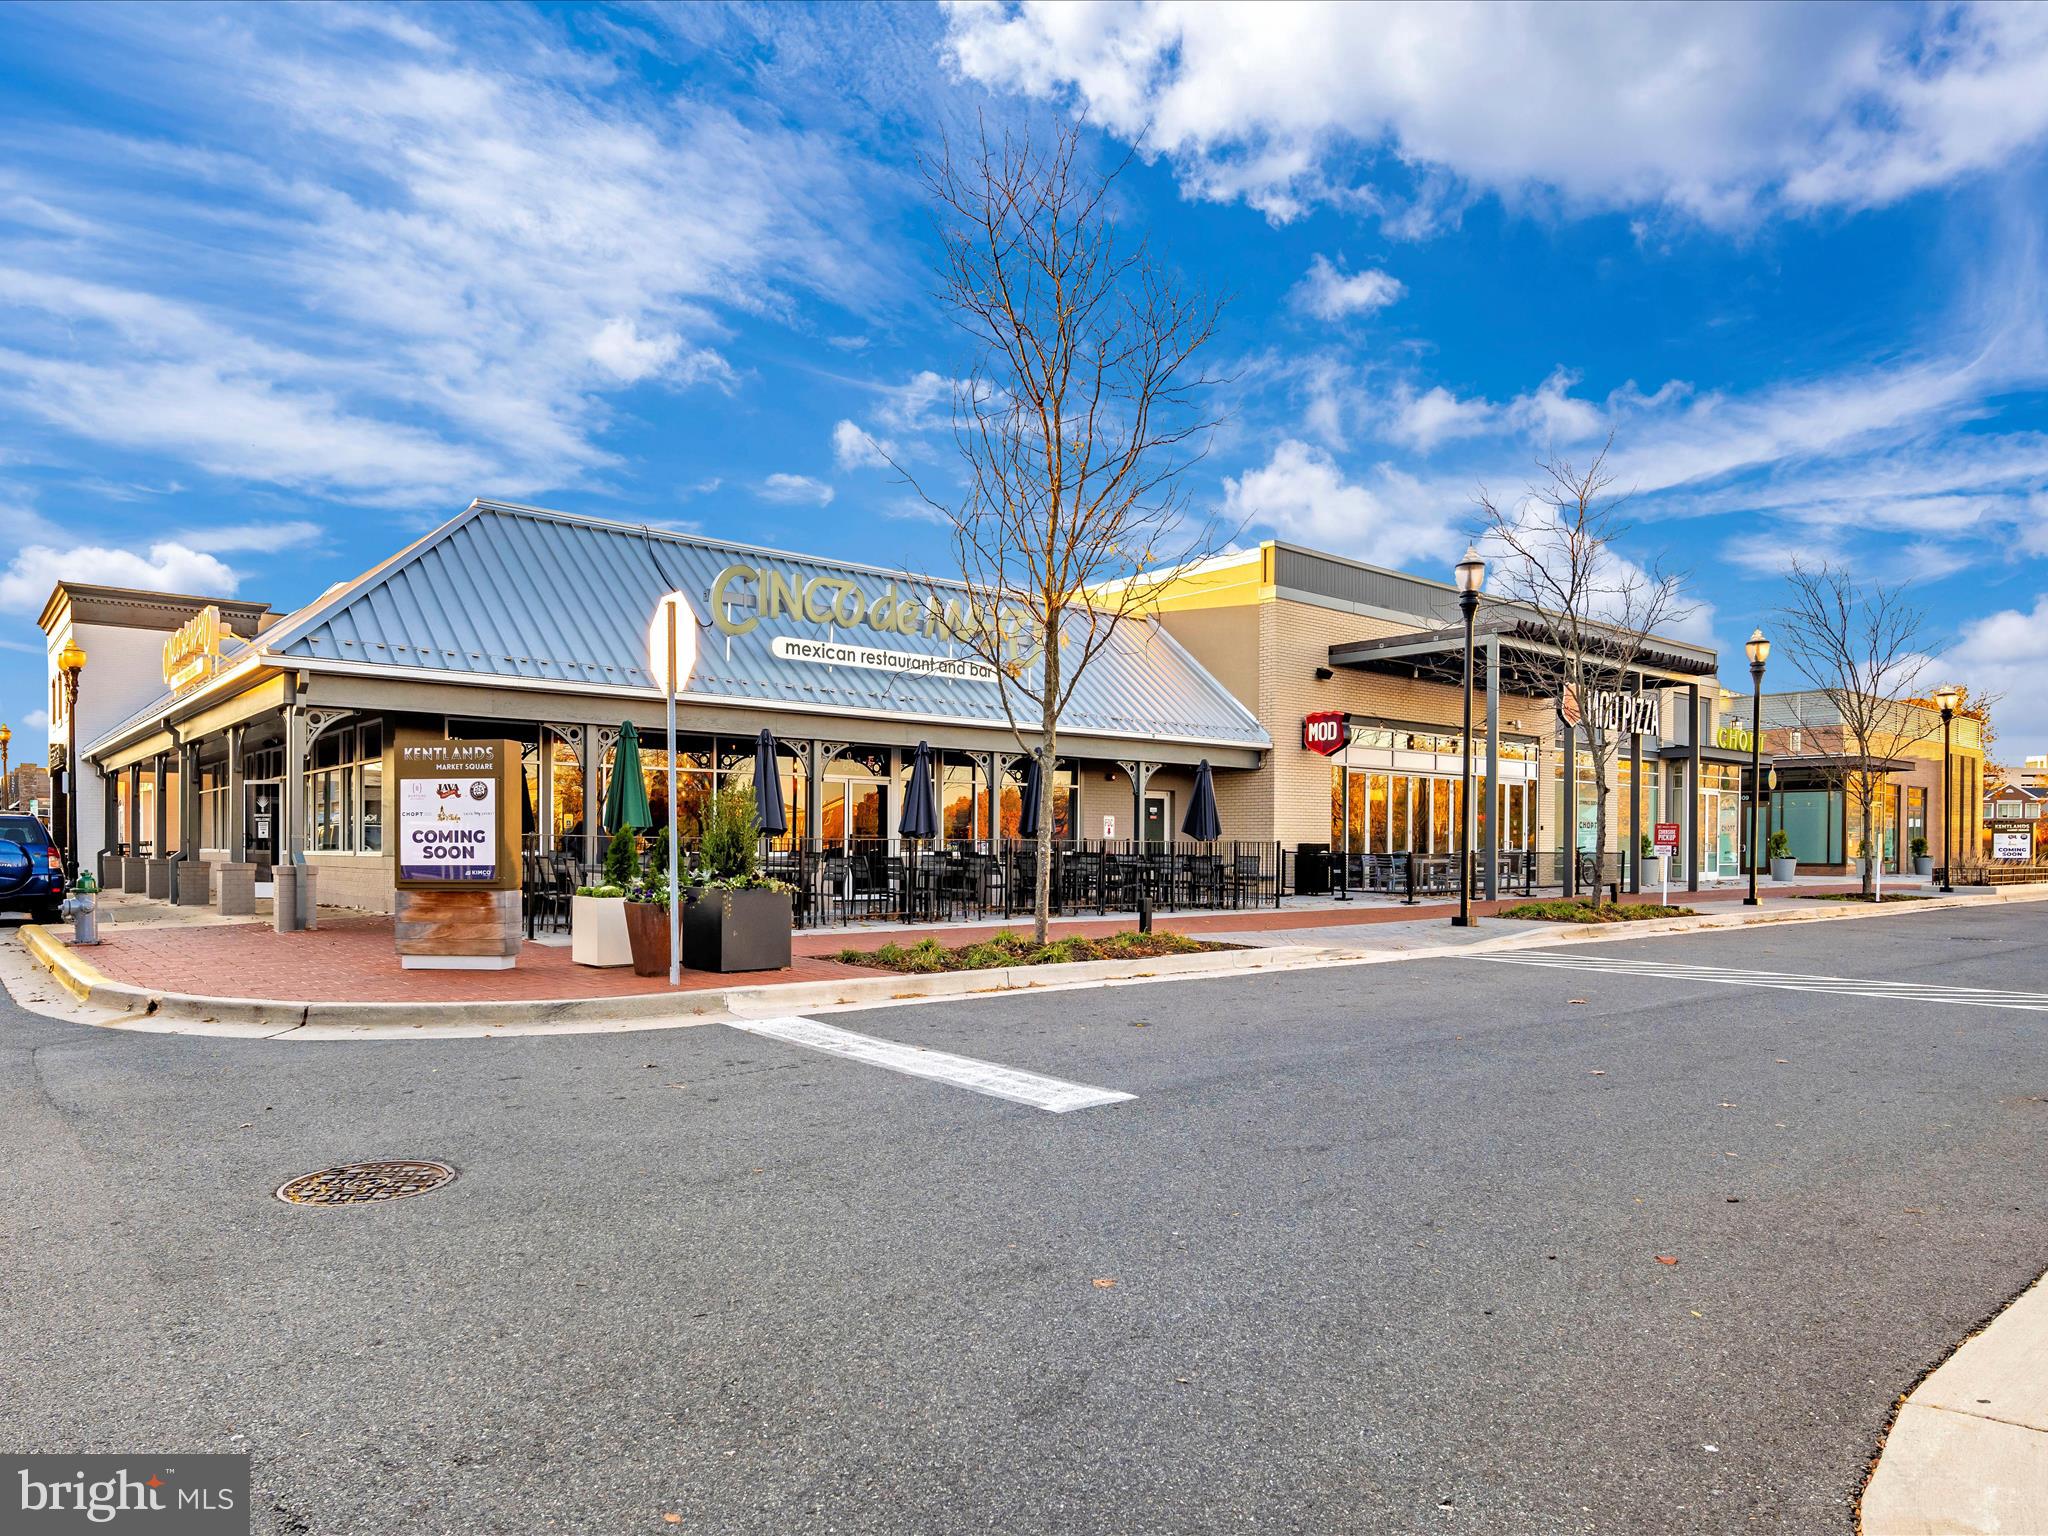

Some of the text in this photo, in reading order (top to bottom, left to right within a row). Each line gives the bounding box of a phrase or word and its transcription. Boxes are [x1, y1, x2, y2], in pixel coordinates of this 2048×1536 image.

[711, 564, 865, 635] CINCO
[868, 584, 921, 636] de
[785, 640, 992, 678] mexican restaurant and bar
[1622, 695, 1660, 736] PIZZA
[1308, 721, 1338, 742] MOD
[403, 746, 495, 761] KENTLANDS
[438, 783, 459, 791] JAVA
[412, 829, 486, 844] COMING
[423, 845, 475, 859] SOON
